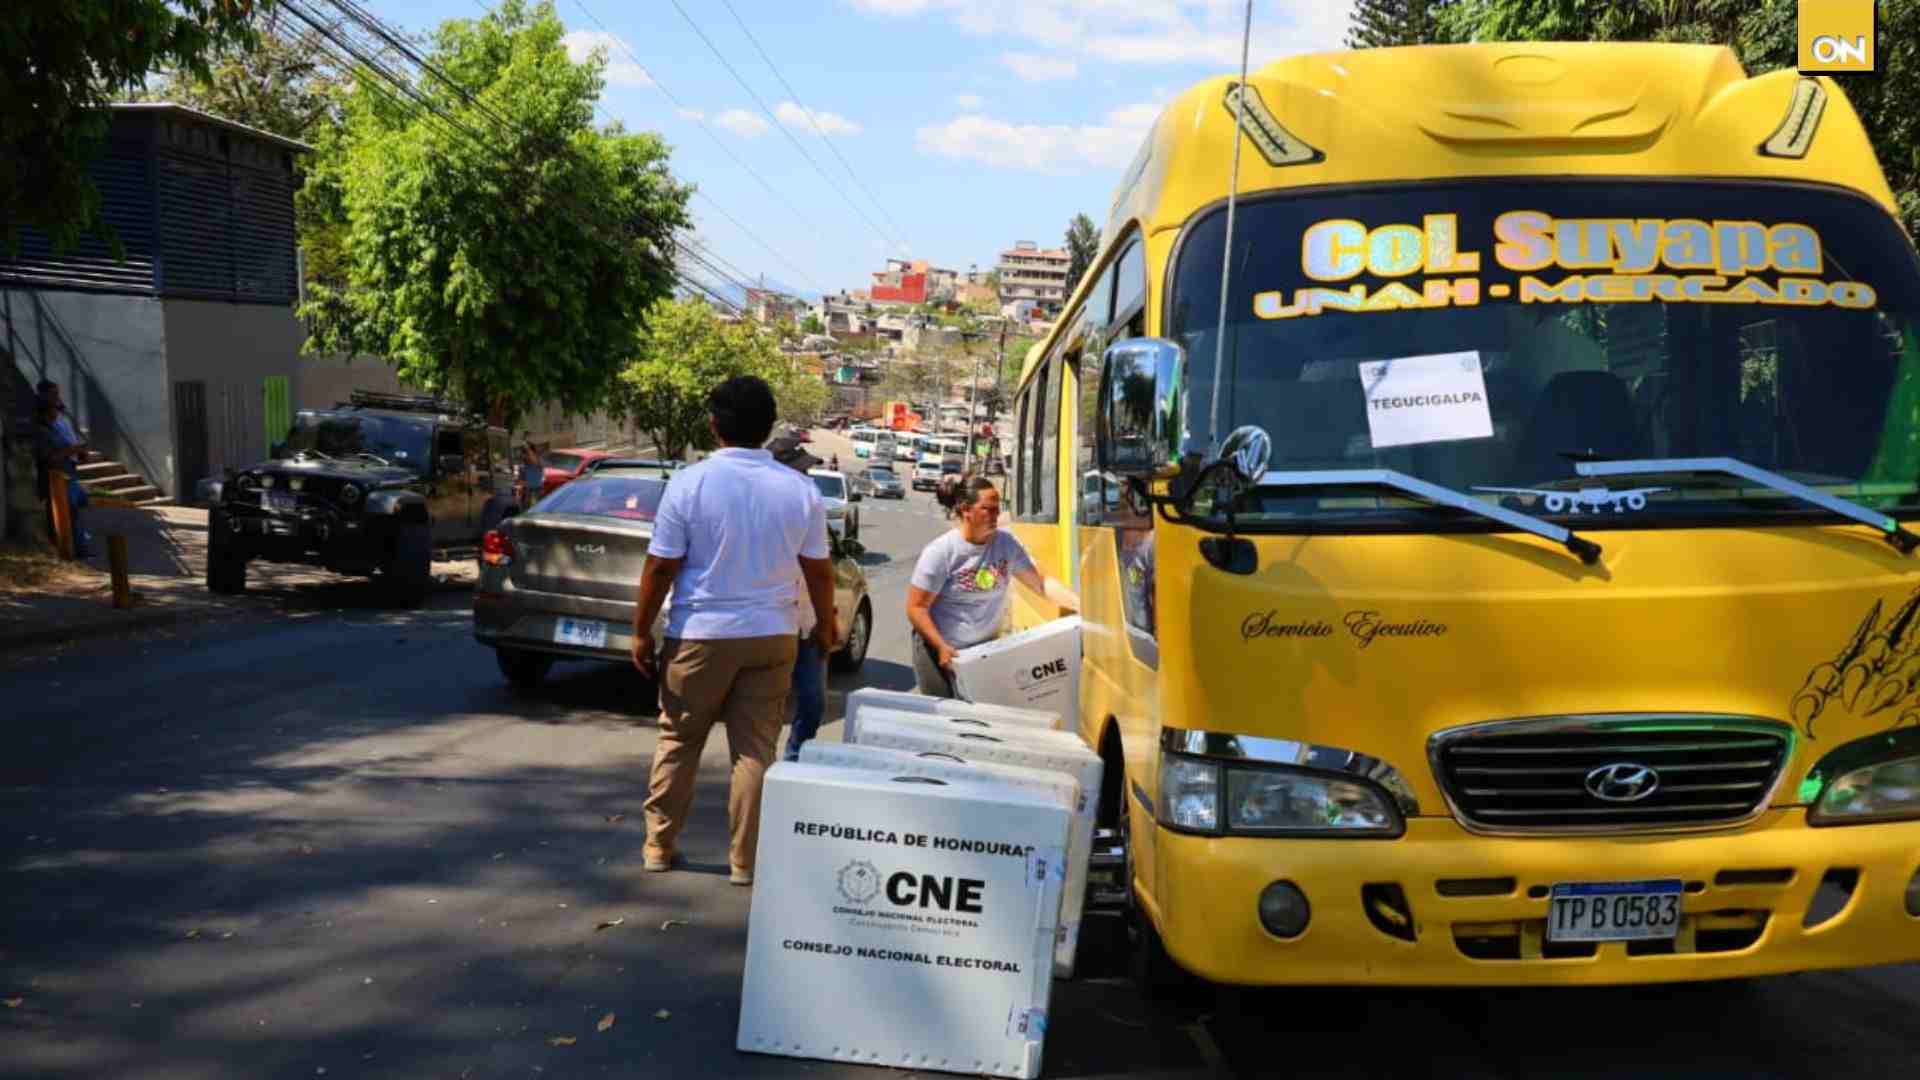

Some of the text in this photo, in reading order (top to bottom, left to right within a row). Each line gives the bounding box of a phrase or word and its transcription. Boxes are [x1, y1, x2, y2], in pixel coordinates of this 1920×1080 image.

[1493, 210, 1824, 277] Suyapa
[1253, 277, 1481, 320] UNAH
[1519, 274, 1877, 309] MERCADO
[1371, 392, 1482, 410] TEGUCIGALPA
[1240, 609, 1448, 650] Servicio Ejecutivo
[1031, 657, 1067, 681] CNE
[793, 820, 898, 845] REPÚBLICA
[903, 833, 928, 848] DE
[885, 870, 986, 915] CNE
[782, 939, 1022, 974] CONSEJO NACIONAL ELECTORAL
